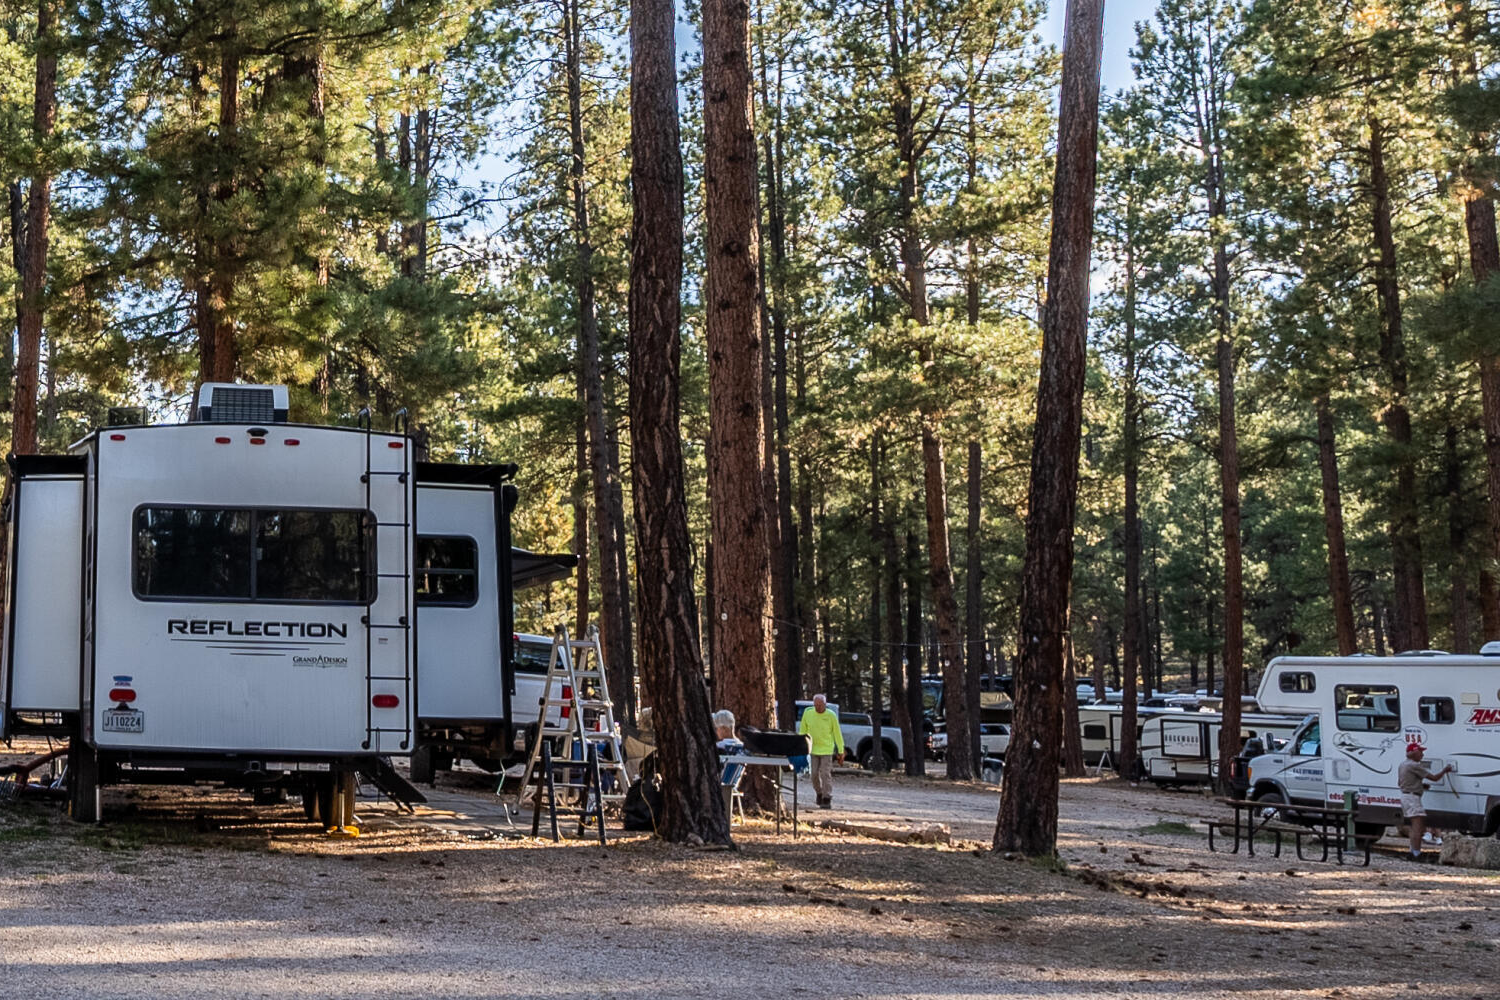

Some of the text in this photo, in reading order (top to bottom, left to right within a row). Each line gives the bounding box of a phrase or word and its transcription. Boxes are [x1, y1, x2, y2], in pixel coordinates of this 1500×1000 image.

[167, 619, 348, 638] REFLECTION
[104, 716, 141, 727] J110224
[1405, 734, 1422, 743] USA
